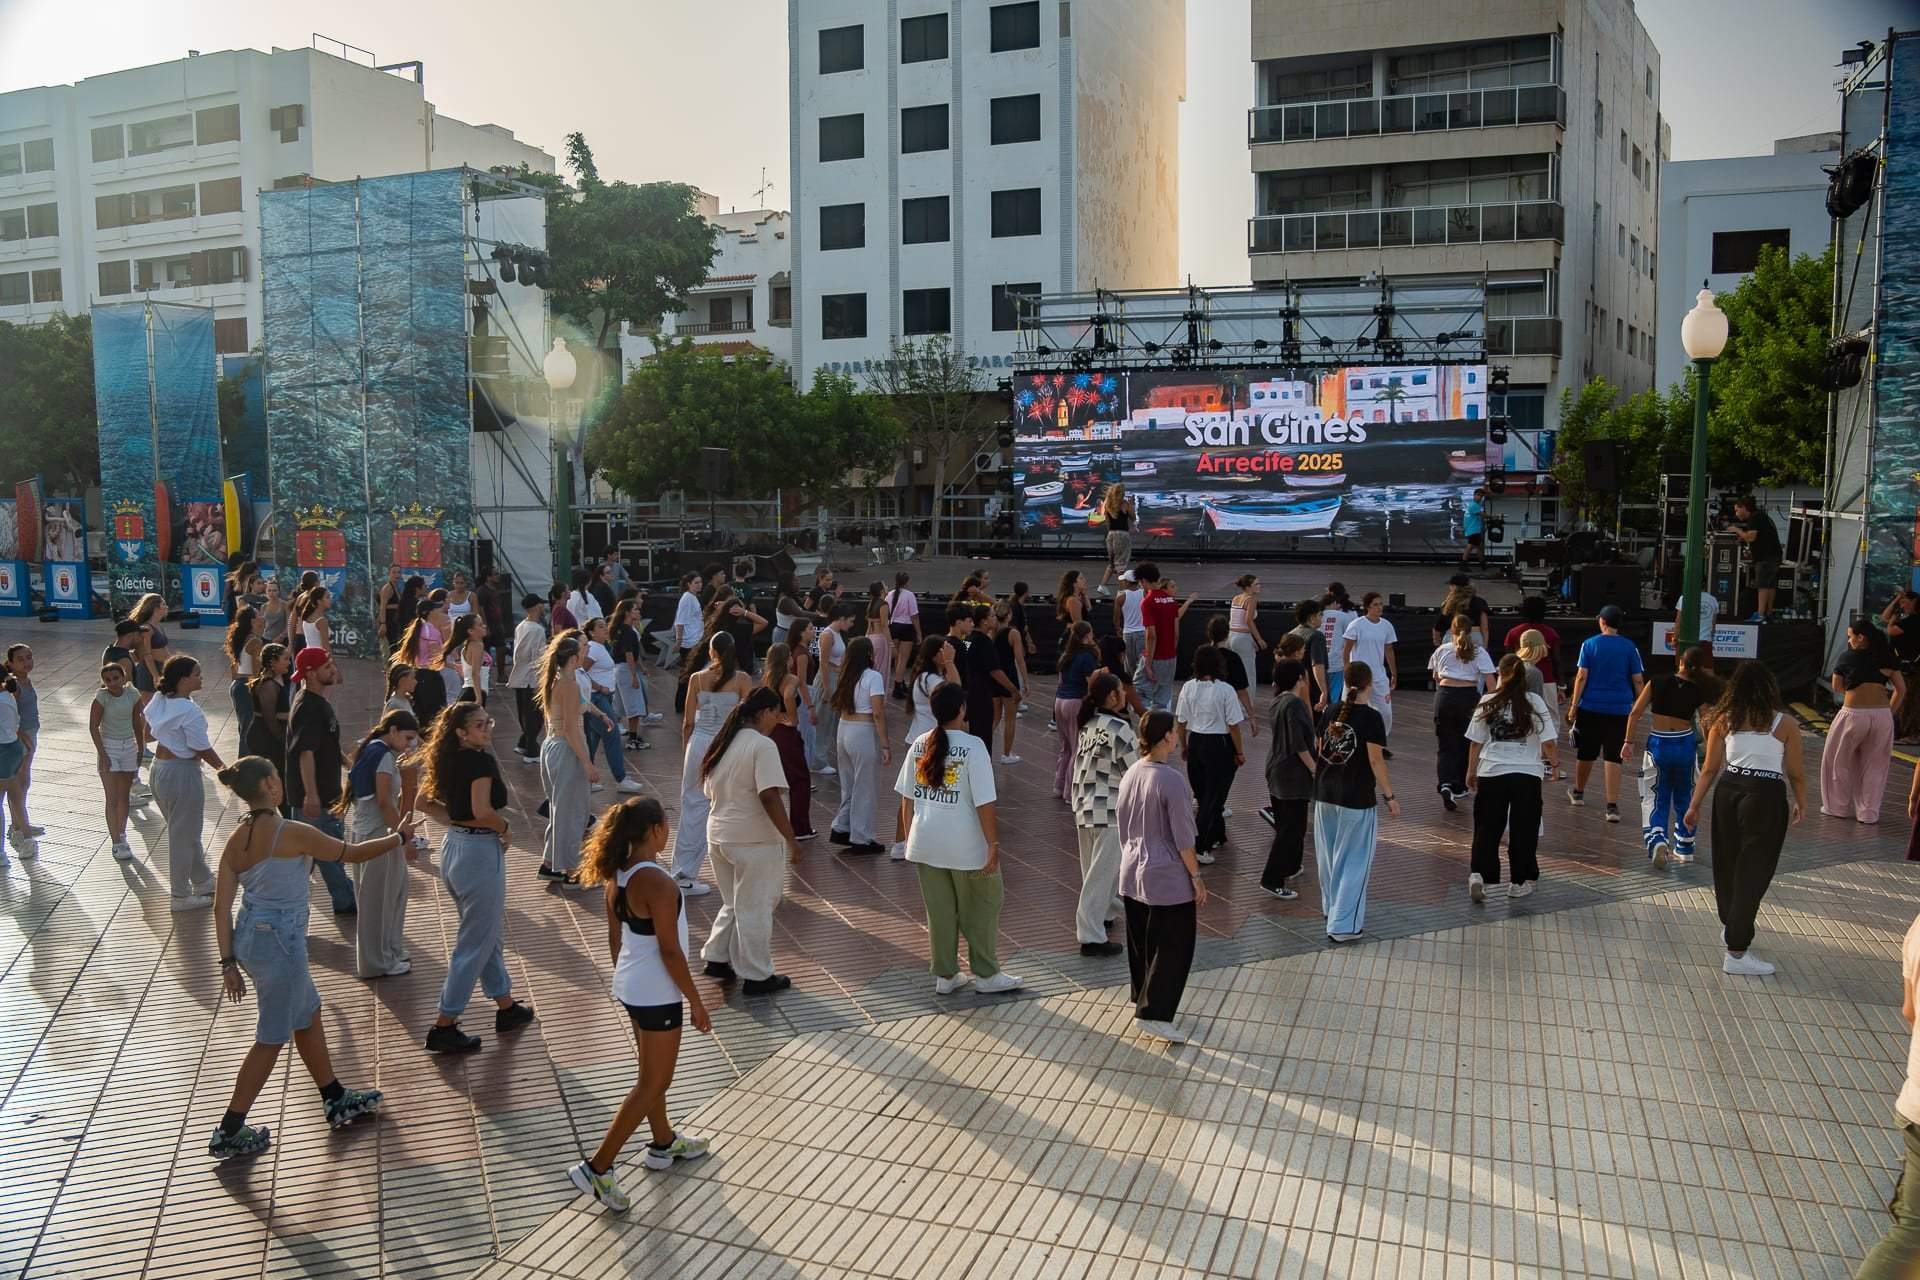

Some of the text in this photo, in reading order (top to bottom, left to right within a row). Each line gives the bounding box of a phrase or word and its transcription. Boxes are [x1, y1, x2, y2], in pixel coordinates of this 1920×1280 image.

[1184, 410, 1367, 447] San Ginés
[1196, 451, 1343, 473] Arrecife 2025
[1753, 770, 1777, 779] NIKE
